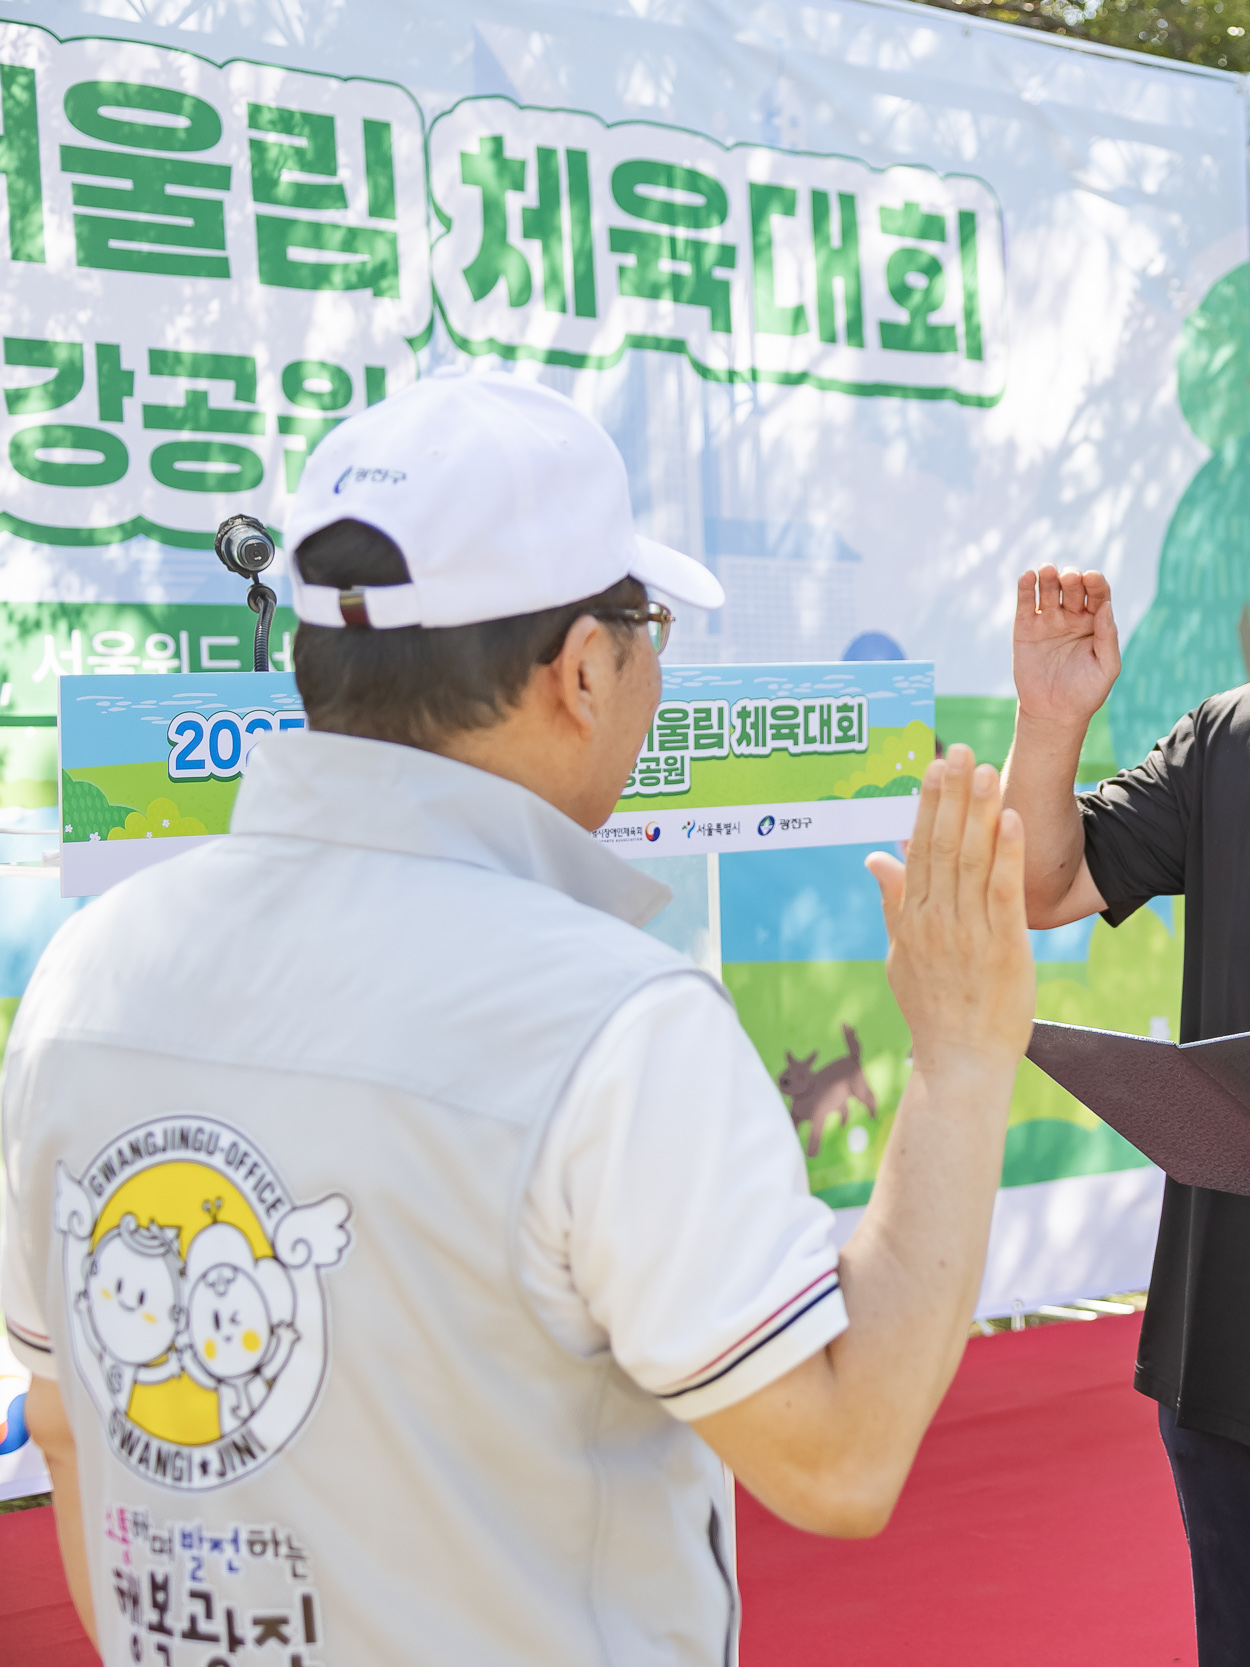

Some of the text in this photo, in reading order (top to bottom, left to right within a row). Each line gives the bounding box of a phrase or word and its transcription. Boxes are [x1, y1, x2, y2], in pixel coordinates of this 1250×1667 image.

[460, 134, 984, 361] 체육대회
[736, 702, 863, 748] 체육대회
[697, 820, 740, 836] 서울특별시
[779, 817, 812, 831] 광진구
